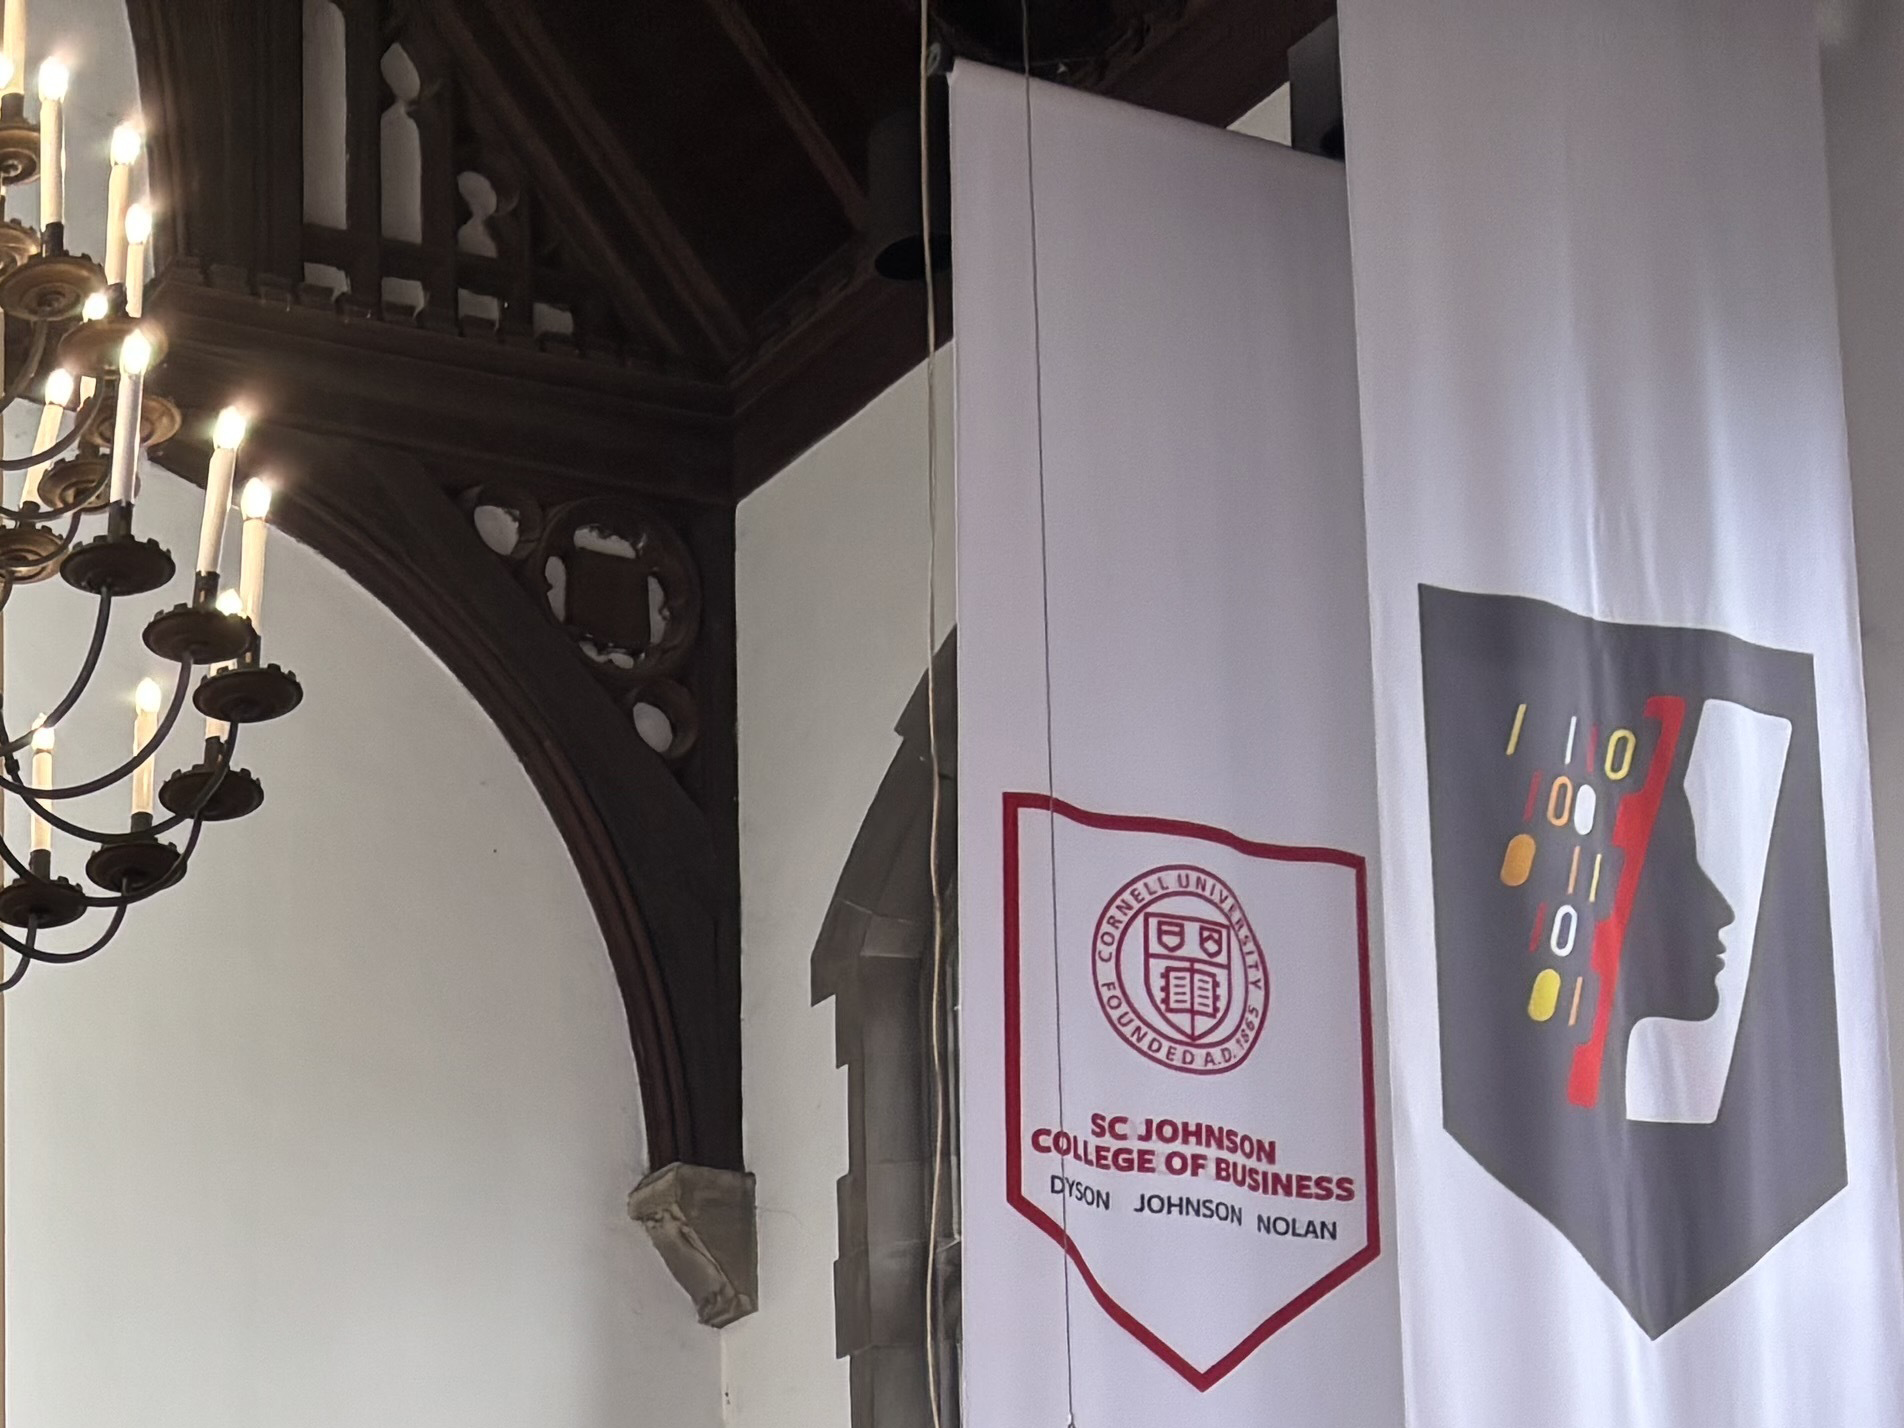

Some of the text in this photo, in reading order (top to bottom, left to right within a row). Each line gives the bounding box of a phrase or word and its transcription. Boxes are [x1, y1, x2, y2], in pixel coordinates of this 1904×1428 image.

[1098, 873, 1262, 991] CORNELL UNIVERSITY
[1101, 981, 1259, 1067] FOUNDED A.D. 1865
[1031, 1128, 1355, 1201] COLLEGE OF BUSINESS
[1091, 1112, 1276, 1165] SC JOHNSON
[1050, 1174, 1337, 1241] DYSON JOHNSON NOLAN
